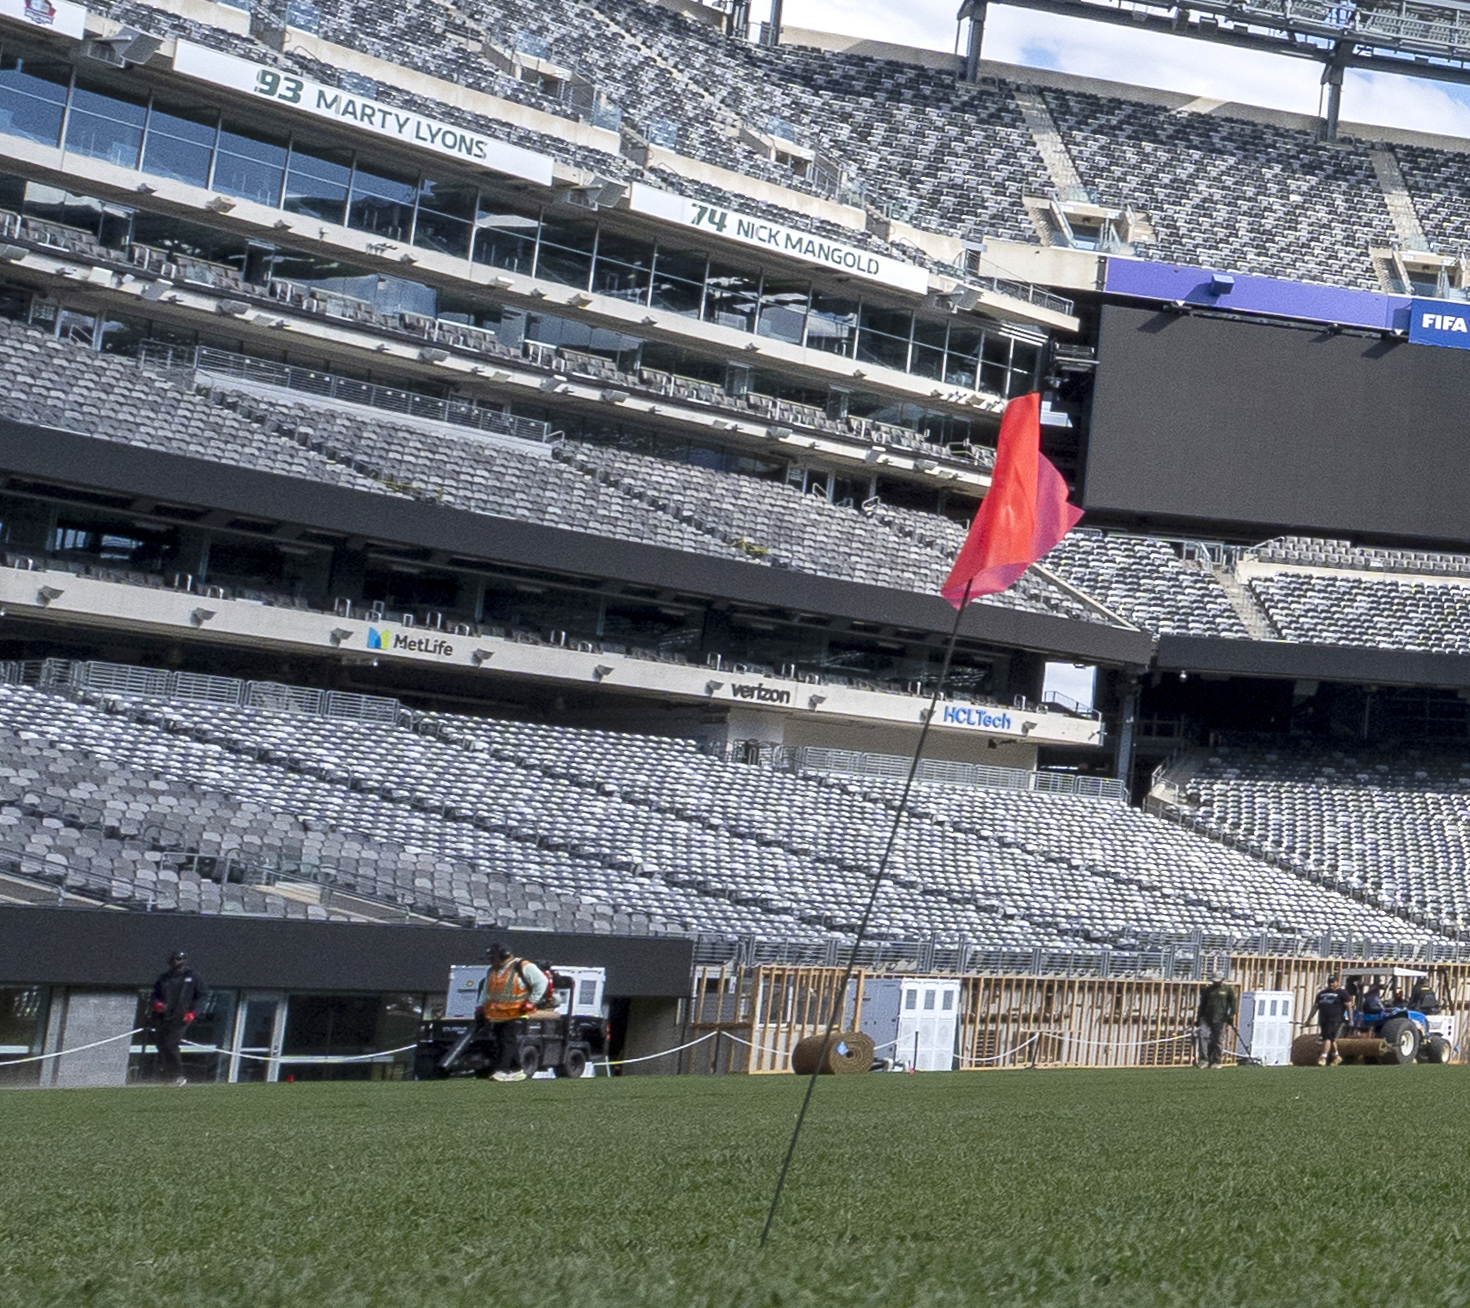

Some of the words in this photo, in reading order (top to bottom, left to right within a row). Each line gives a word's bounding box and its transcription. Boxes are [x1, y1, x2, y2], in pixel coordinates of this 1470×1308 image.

[254, 70, 304, 104] 93
[316, 89, 410, 134] MARTY
[415, 121, 488, 159] LYONS
[691, 203, 728, 232] 74
[737, 219, 781, 247] NICK
[784, 233, 879, 275] MANGOLD
[1422, 313, 1467, 333] FIFA
[393, 634, 453, 656] MetLife
[731, 683, 791, 704] verizon
[944, 705, 1011, 729] HCLTech
